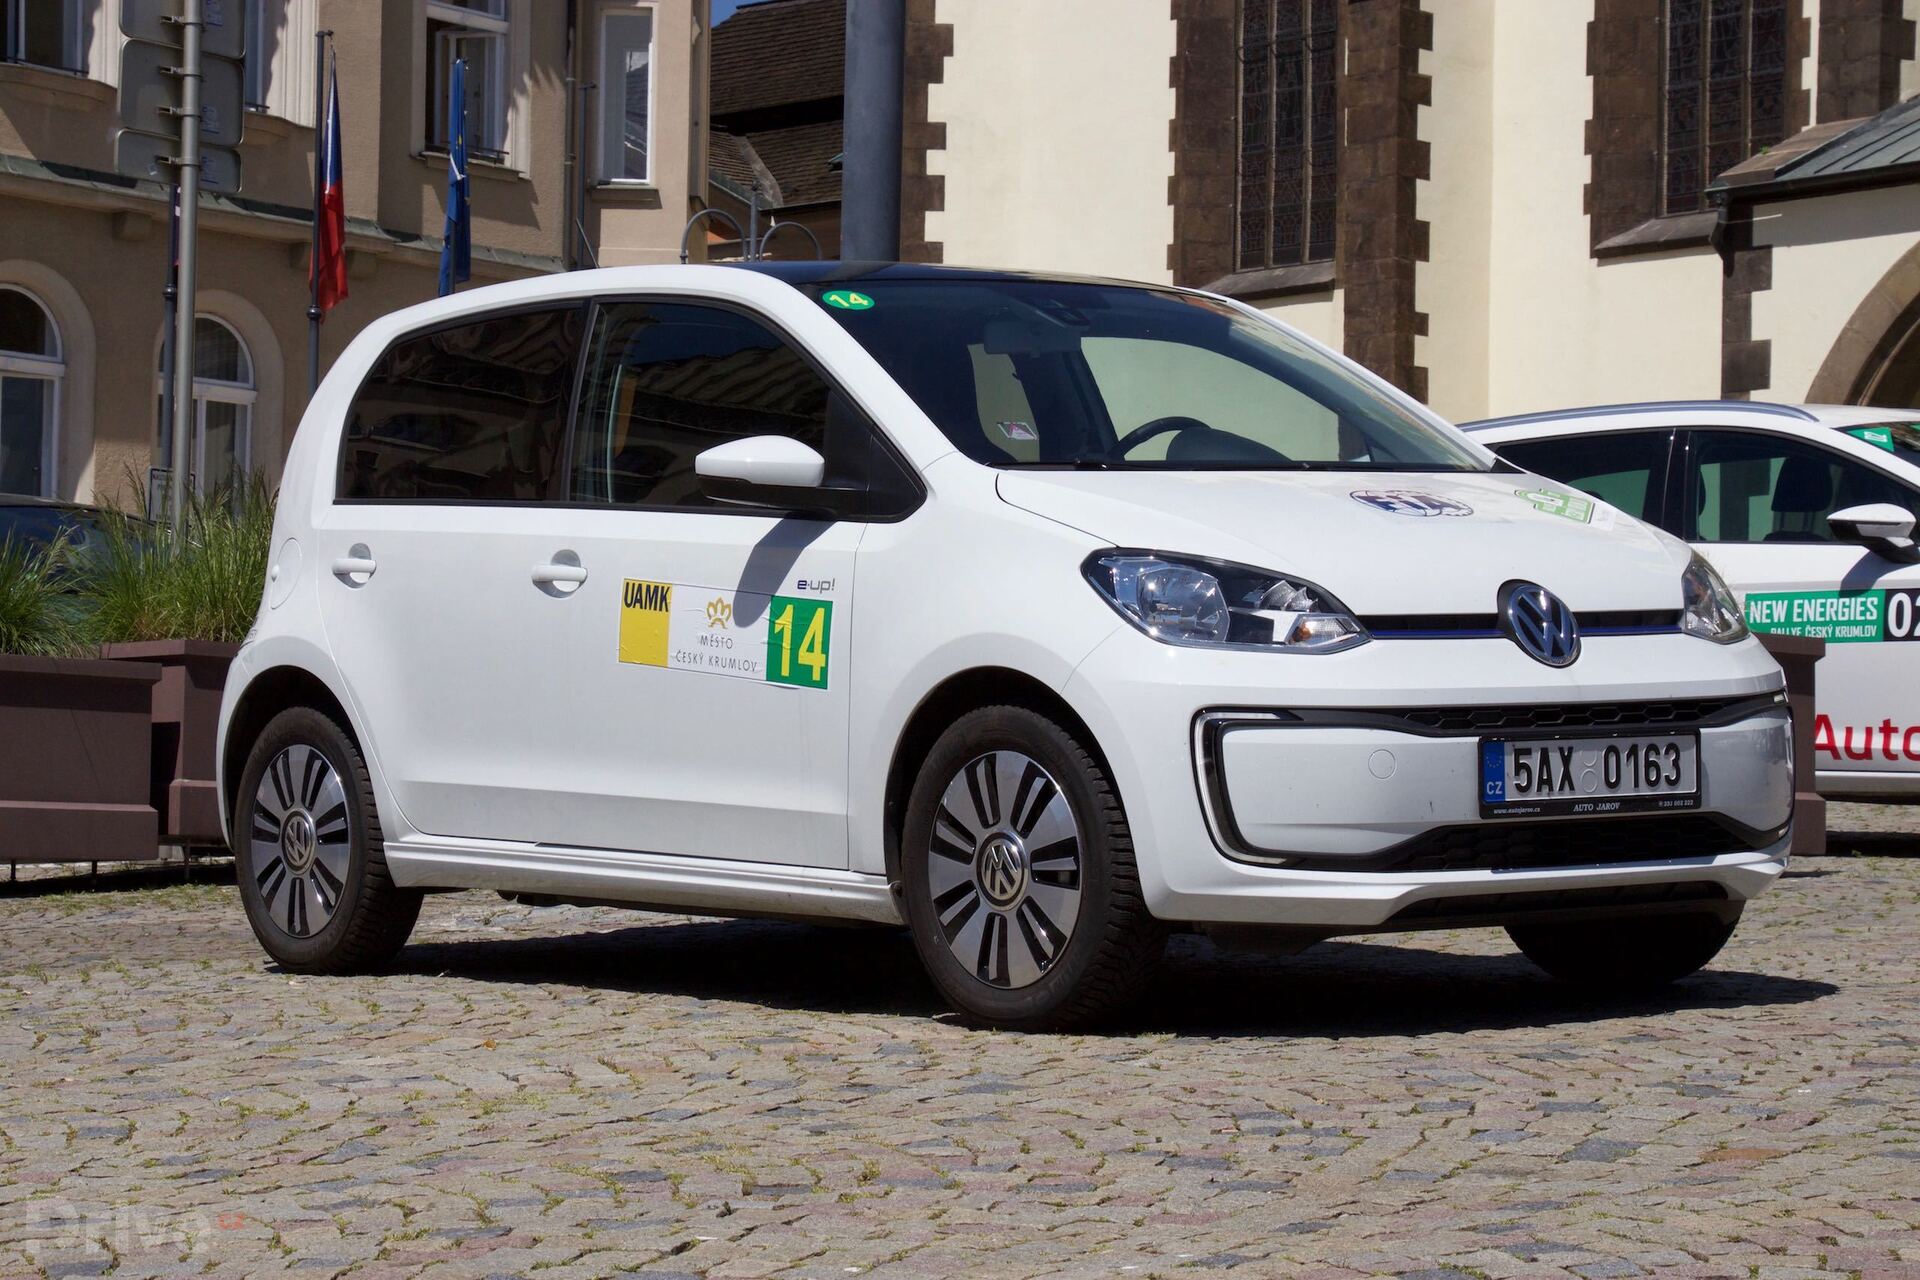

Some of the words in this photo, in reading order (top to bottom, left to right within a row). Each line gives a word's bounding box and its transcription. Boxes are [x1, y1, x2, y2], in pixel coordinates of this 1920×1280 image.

[829, 293, 869, 307] 14
[624, 581, 670, 612] UAMK
[1749, 600, 1788, 624] NEW
[1792, 597, 1878, 622] ENERGIES
[1835, 625, 1877, 638] KRUMLOV
[774, 603, 826, 681] 14
[708, 655, 758, 672] KRUMLOV
[1513, 744, 1576, 793] 5AX
[1603, 742, 1682, 790] 0163
[1486, 781, 1503, 795] CZ
[1573, 803, 1594, 812] AUTO
[1596, 802, 1621, 811] JAROV
